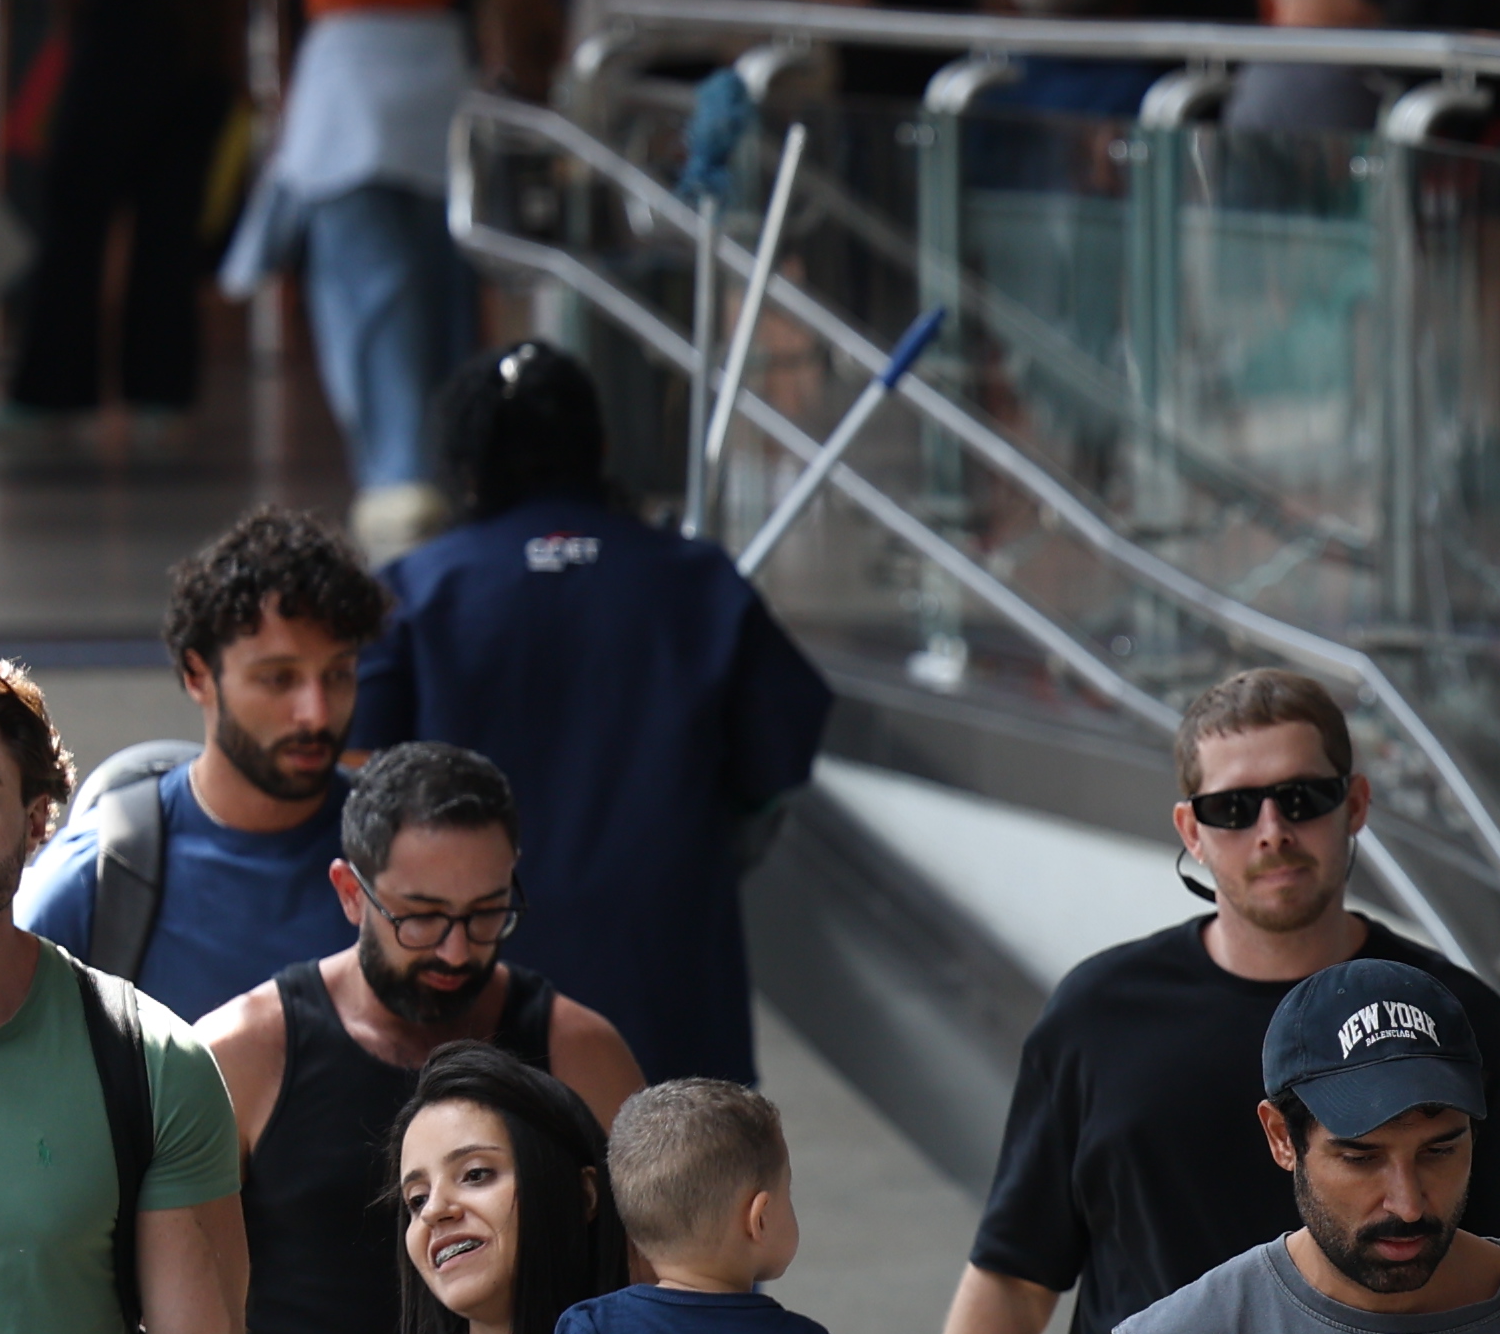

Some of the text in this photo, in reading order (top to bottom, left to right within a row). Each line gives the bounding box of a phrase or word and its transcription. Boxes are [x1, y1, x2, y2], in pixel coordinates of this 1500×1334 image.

[1338, 1000, 1441, 1060] NEW YORK
[1365, 1029, 1418, 1047] BALENCIAGA
